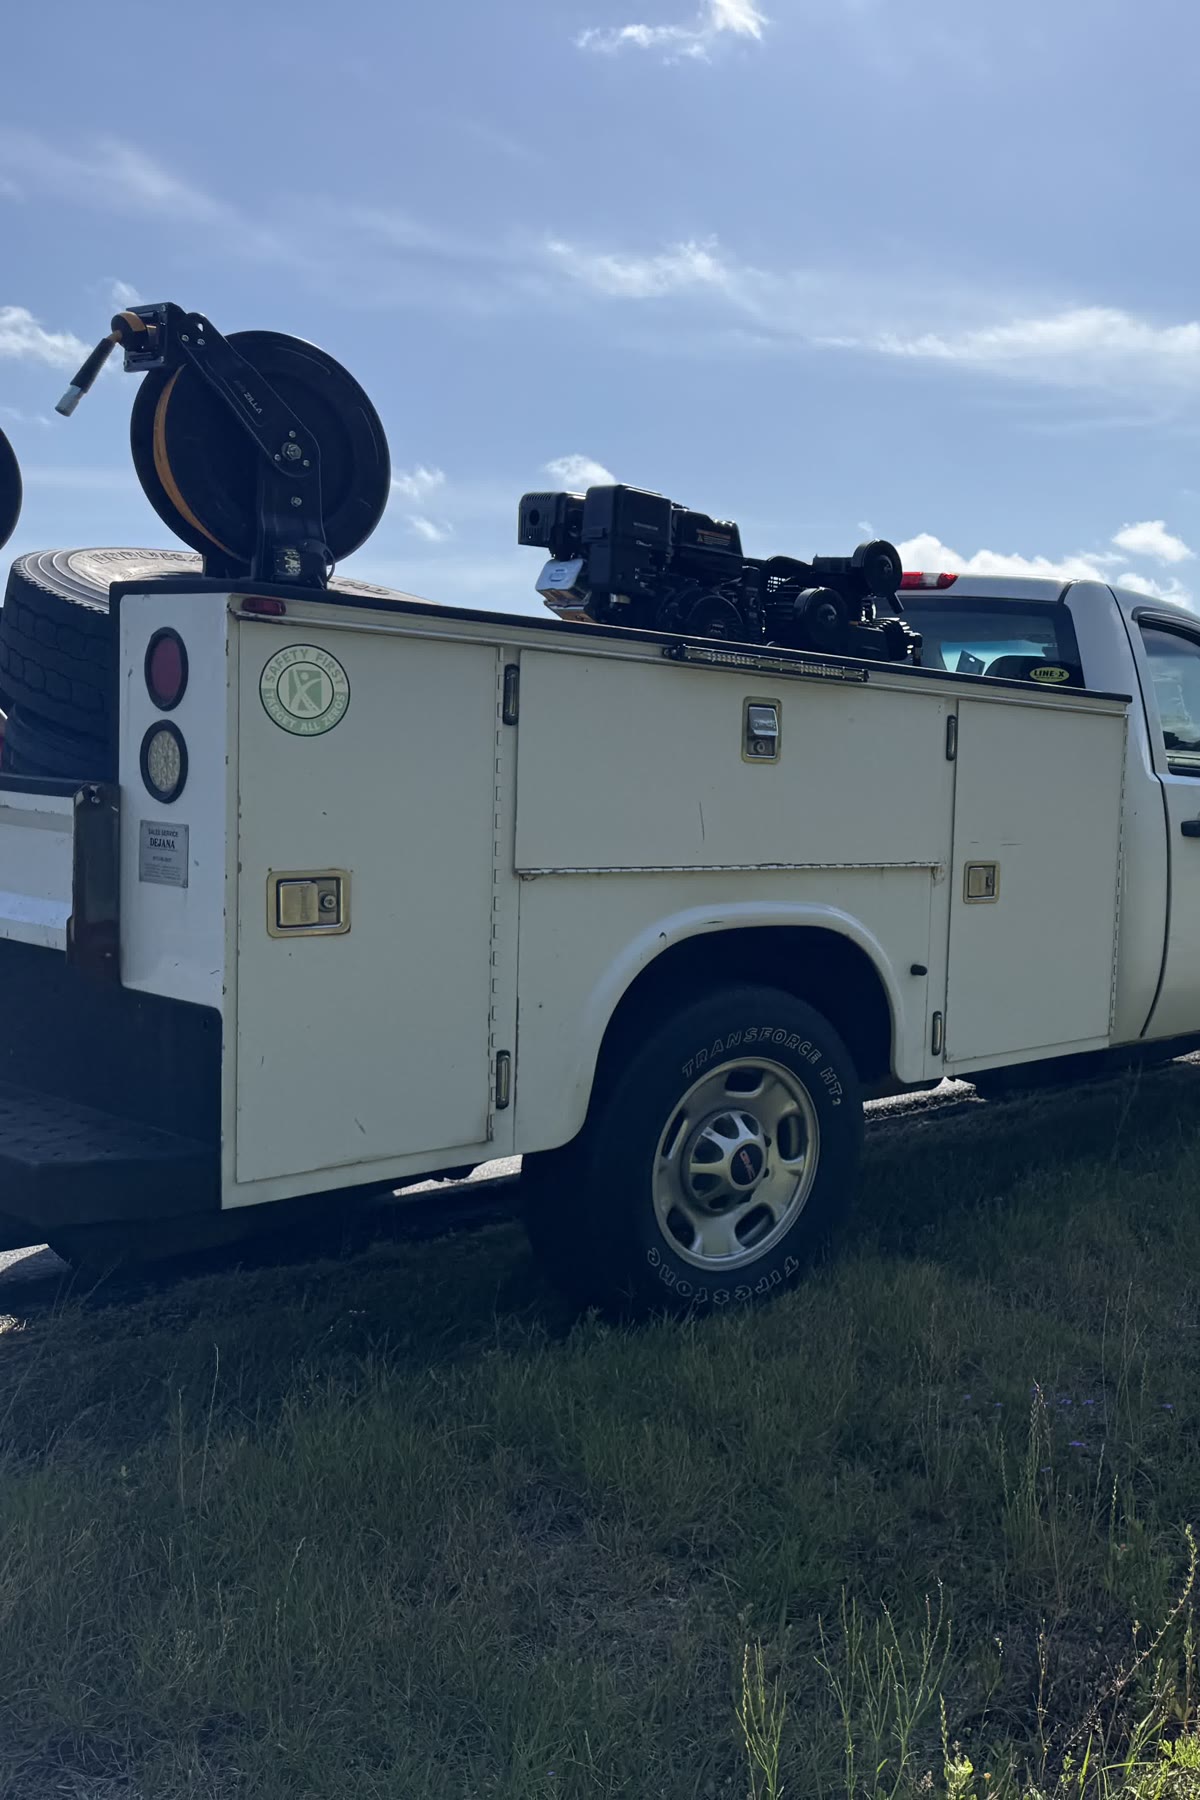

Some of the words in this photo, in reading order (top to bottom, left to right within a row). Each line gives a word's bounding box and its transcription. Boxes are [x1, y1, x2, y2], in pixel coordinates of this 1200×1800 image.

[264, 649, 309, 683] SAFETY
[315, 651, 346, 685] FIRST
[265, 691, 297, 728] TARGET
[300, 721, 321, 732] ALL
[323, 693, 346, 726] ZEROS
[149, 837, 175, 849] DEJANA
[681, 1030, 823, 1078] TRANSFORCE
